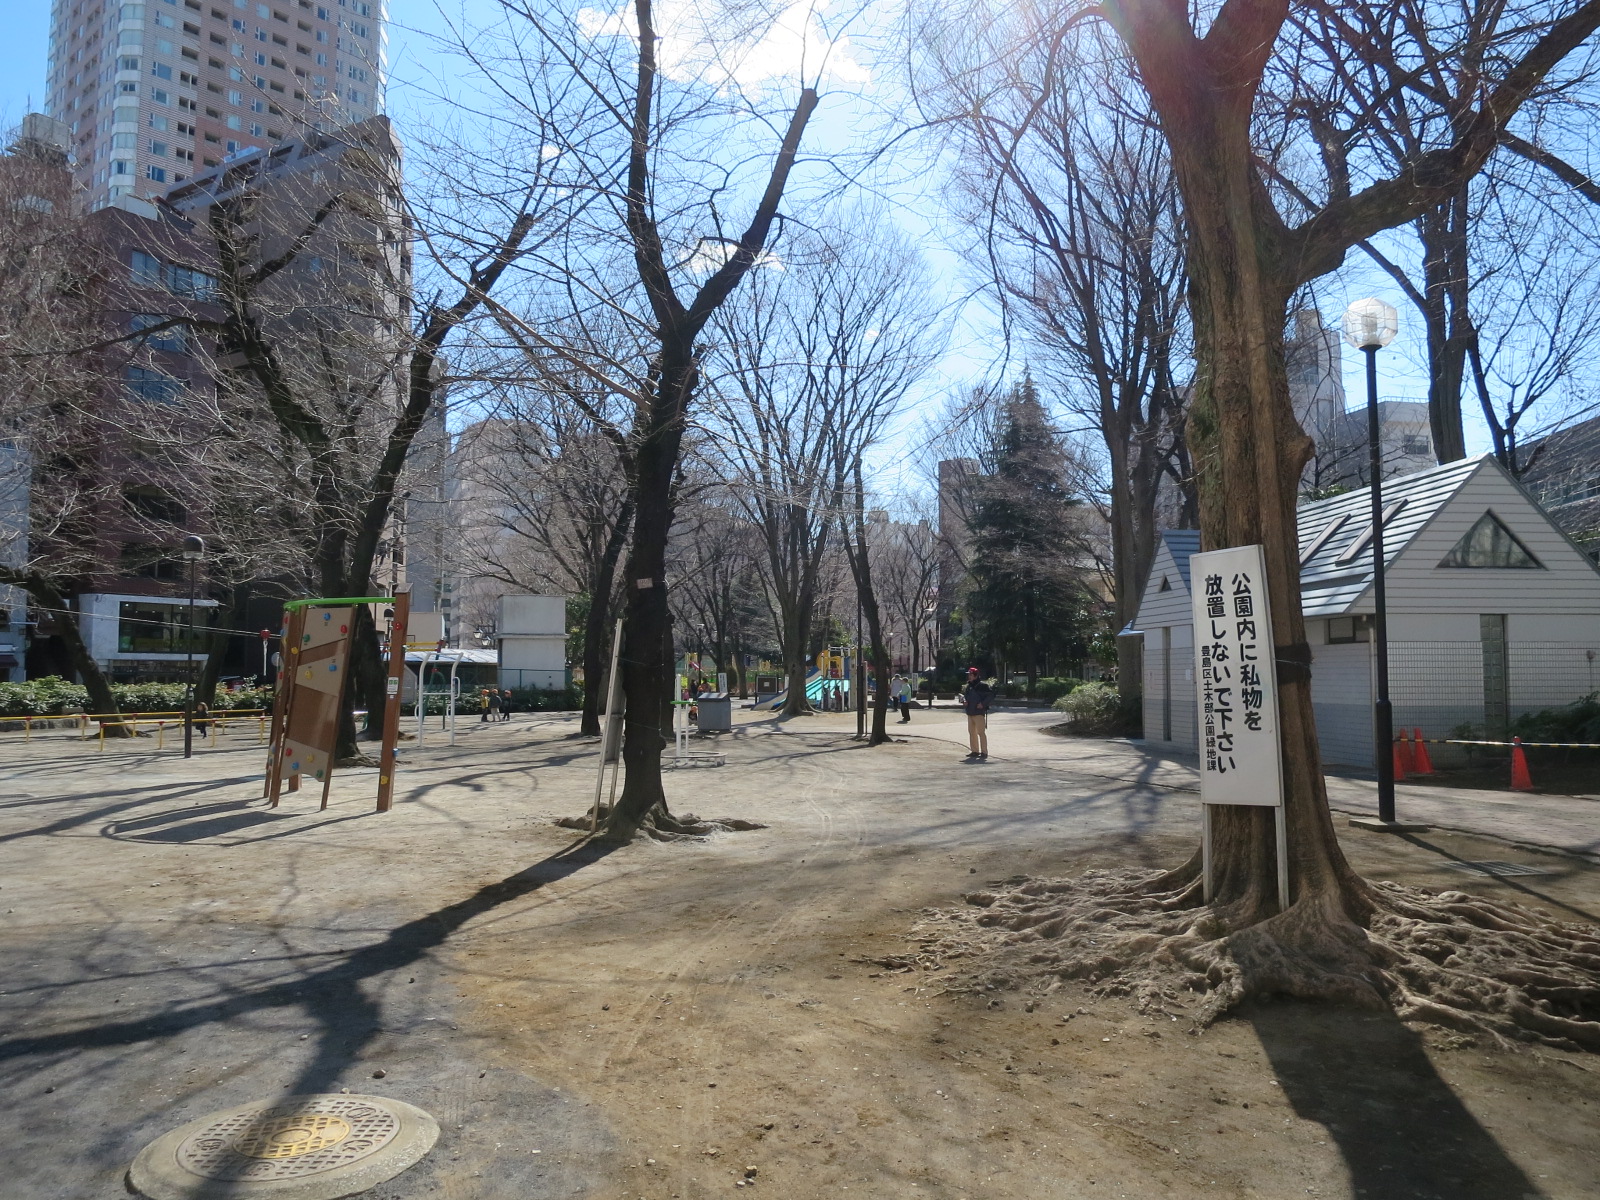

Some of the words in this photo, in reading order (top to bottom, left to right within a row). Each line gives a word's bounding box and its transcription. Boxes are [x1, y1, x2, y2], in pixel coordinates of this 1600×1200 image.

[1201, 646, 1217, 771] 豊島区土木部公園緑地課
[1205, 574, 1236, 774] 放置しないで下さい
[1231, 572, 1263, 731] 公園内に私物を
